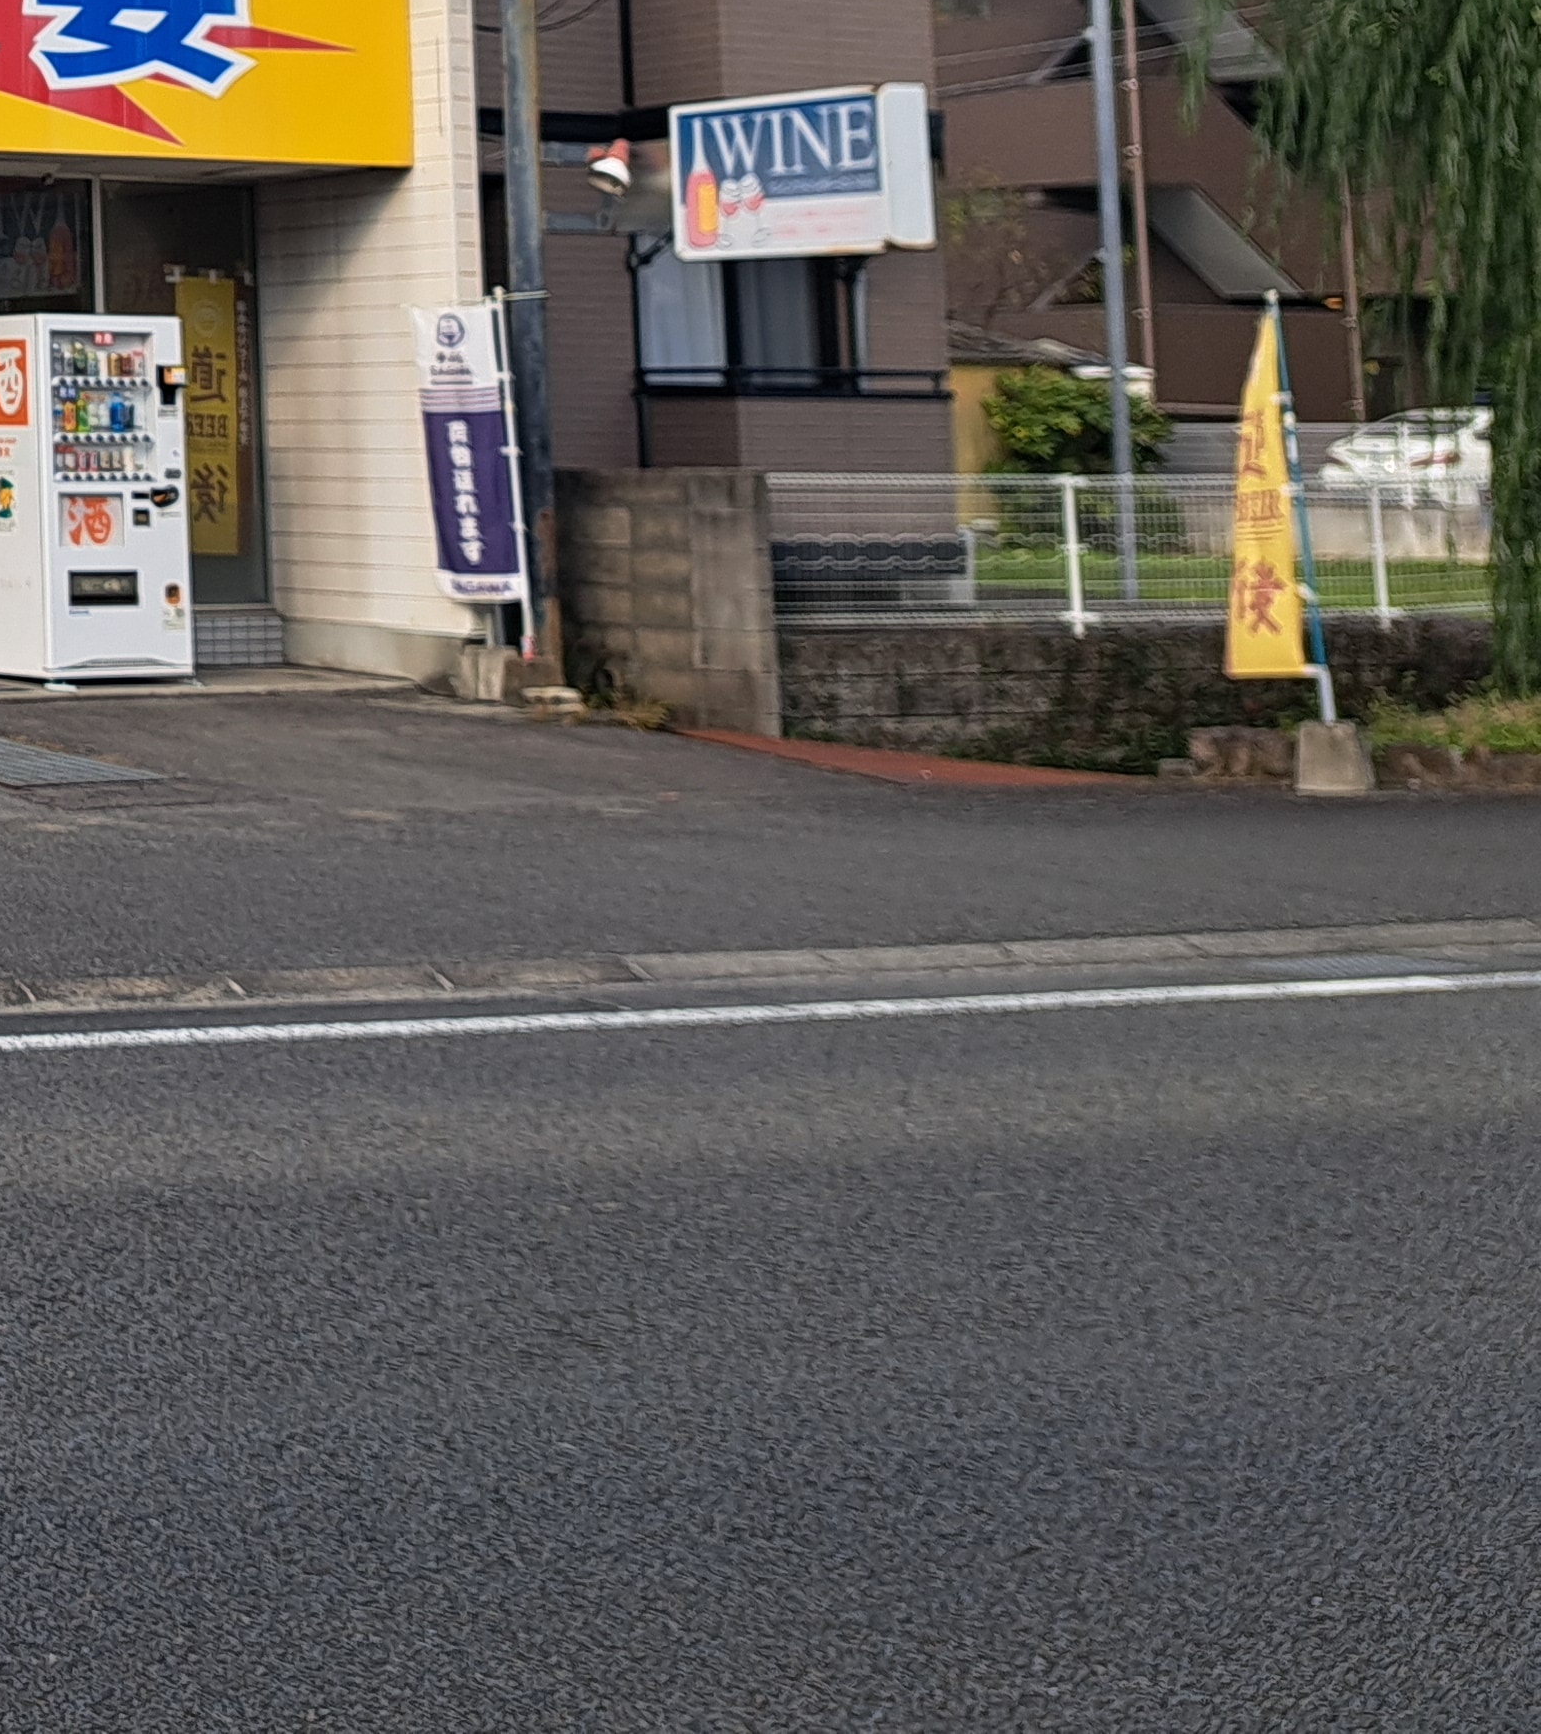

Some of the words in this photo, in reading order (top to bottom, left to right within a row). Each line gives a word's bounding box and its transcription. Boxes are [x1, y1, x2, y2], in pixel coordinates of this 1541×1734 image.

[709, 104, 877, 177] WINE
[67, 495, 115, 546] 酒
[1232, 555, 1288, 637] 後
